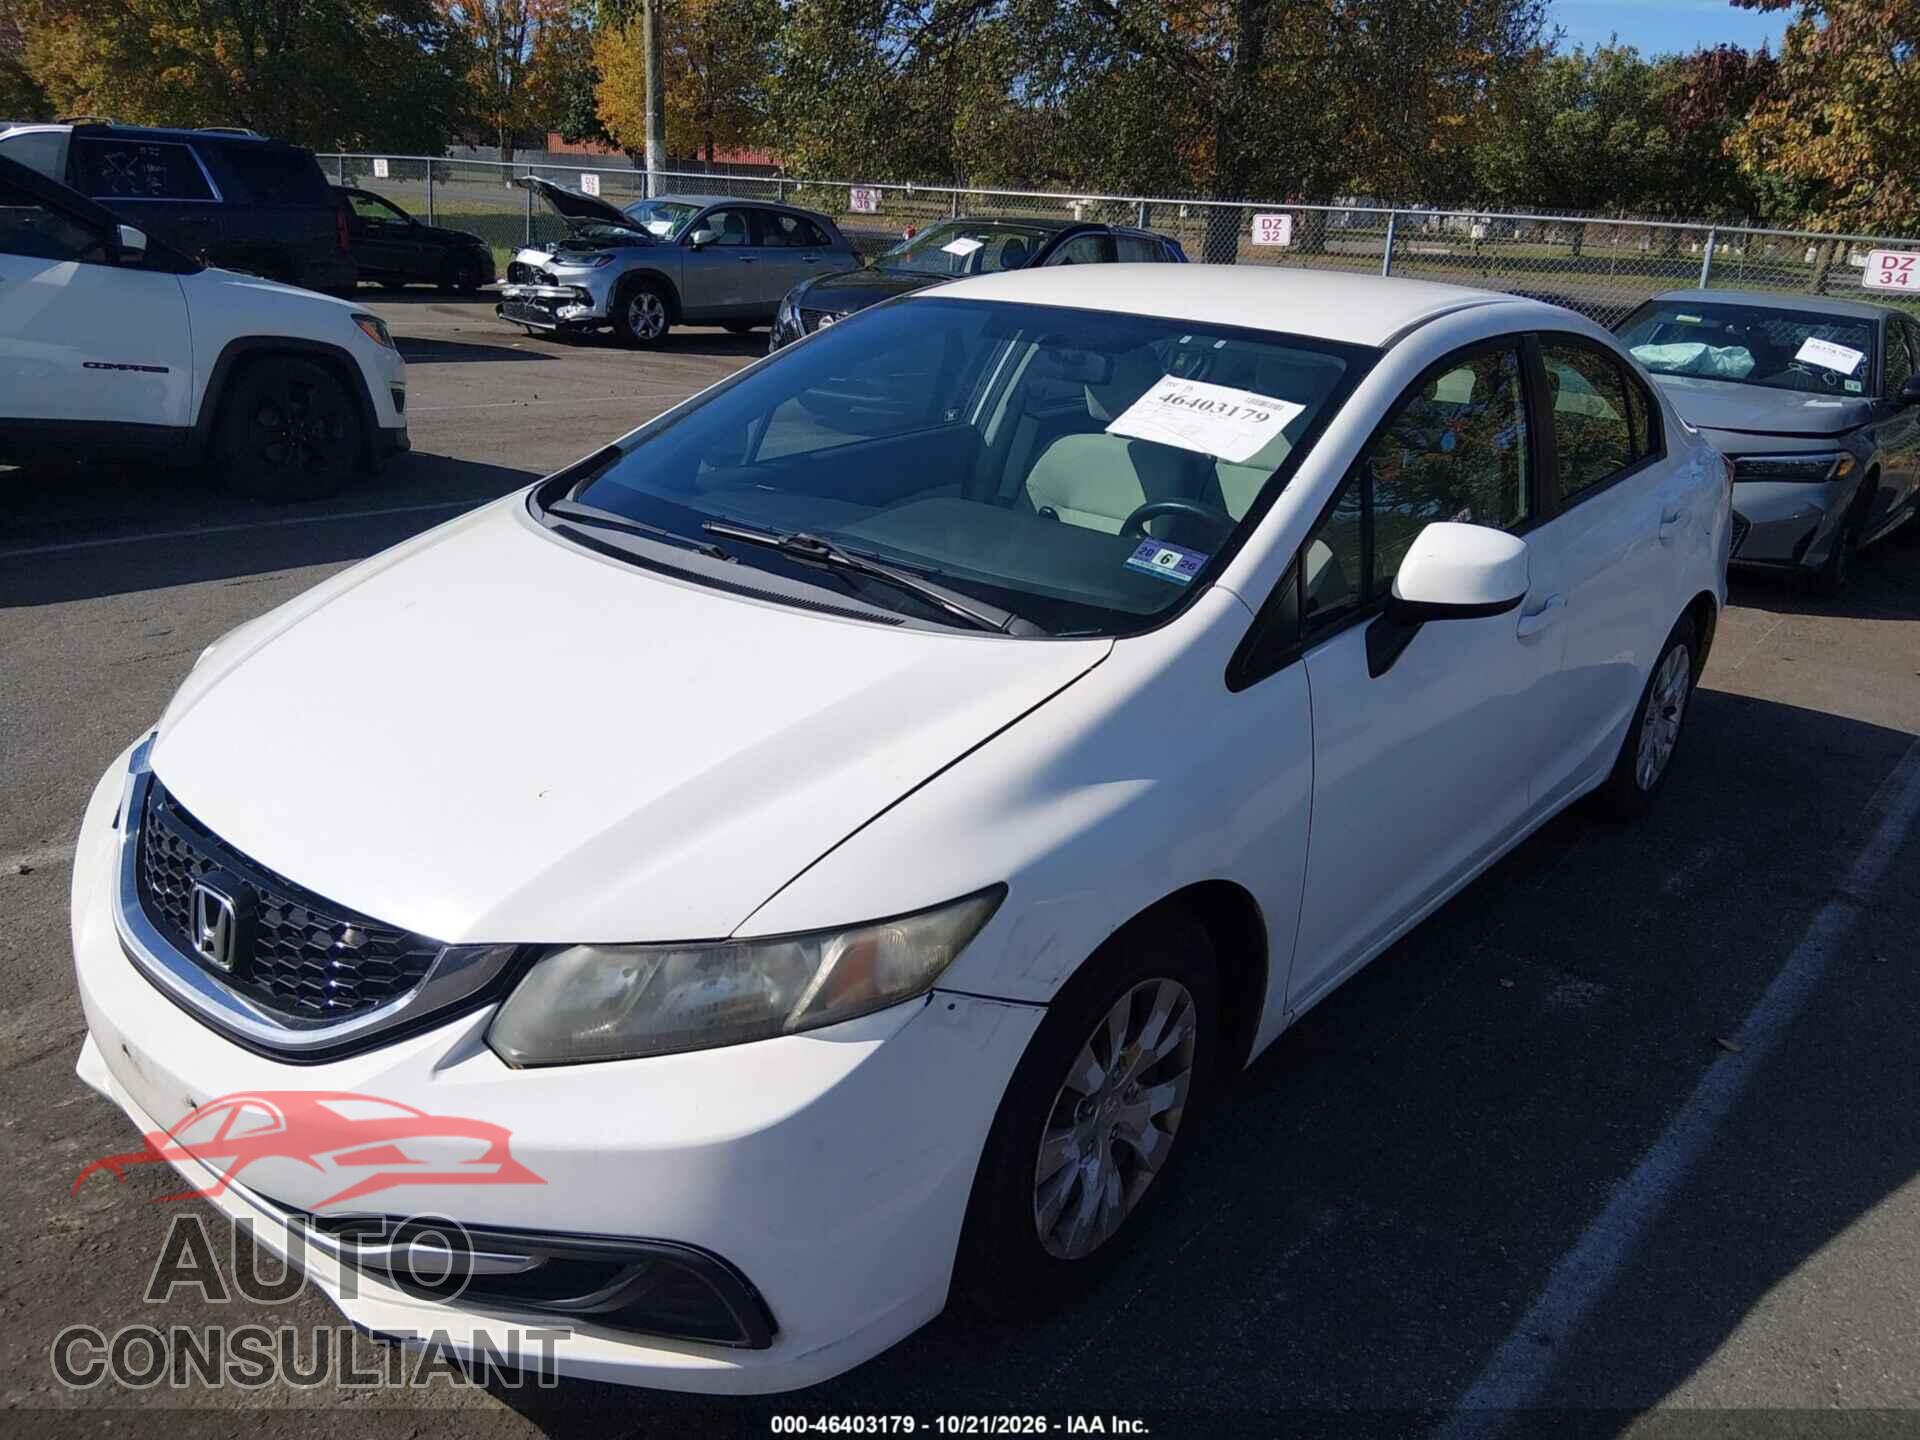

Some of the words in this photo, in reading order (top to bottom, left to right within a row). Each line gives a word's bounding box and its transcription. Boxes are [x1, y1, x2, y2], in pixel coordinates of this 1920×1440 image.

[857, 190, 870, 199] DZ
[1262, 219, 1282, 230] DZ
[1262, 231, 1280, 241] 32
[1881, 256, 1916, 271] DZ
[1880, 271, 1908, 285] 34
[1158, 392, 1271, 424] 46403179
[1160, 553, 1174, 565] 6
